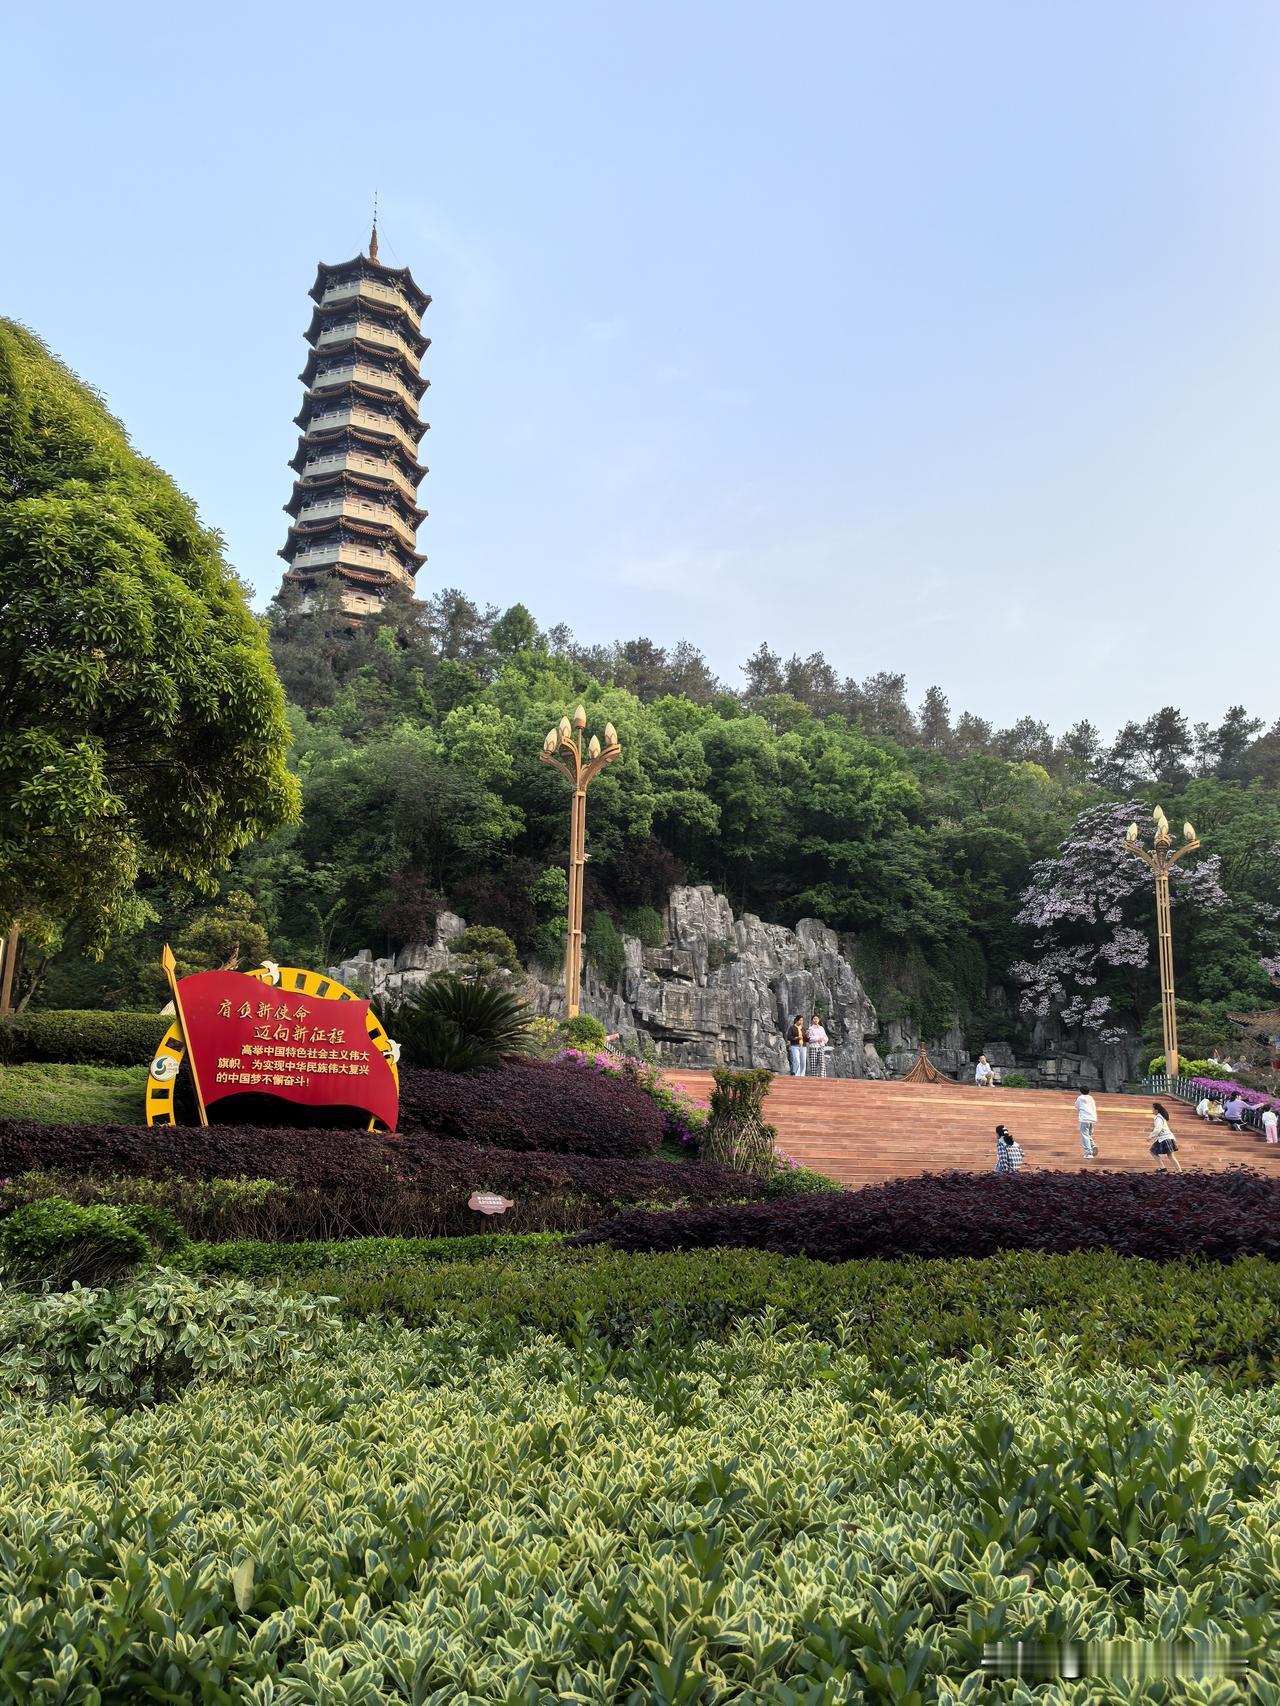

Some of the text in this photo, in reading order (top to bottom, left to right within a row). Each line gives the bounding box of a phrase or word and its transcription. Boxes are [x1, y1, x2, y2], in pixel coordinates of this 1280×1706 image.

[217, 999, 311, 1022] 肩负新使命
[254, 1024, 346, 1044] 迈向新征程
[241, 1044, 370, 1061] 高举中国特色社会主义伟大
